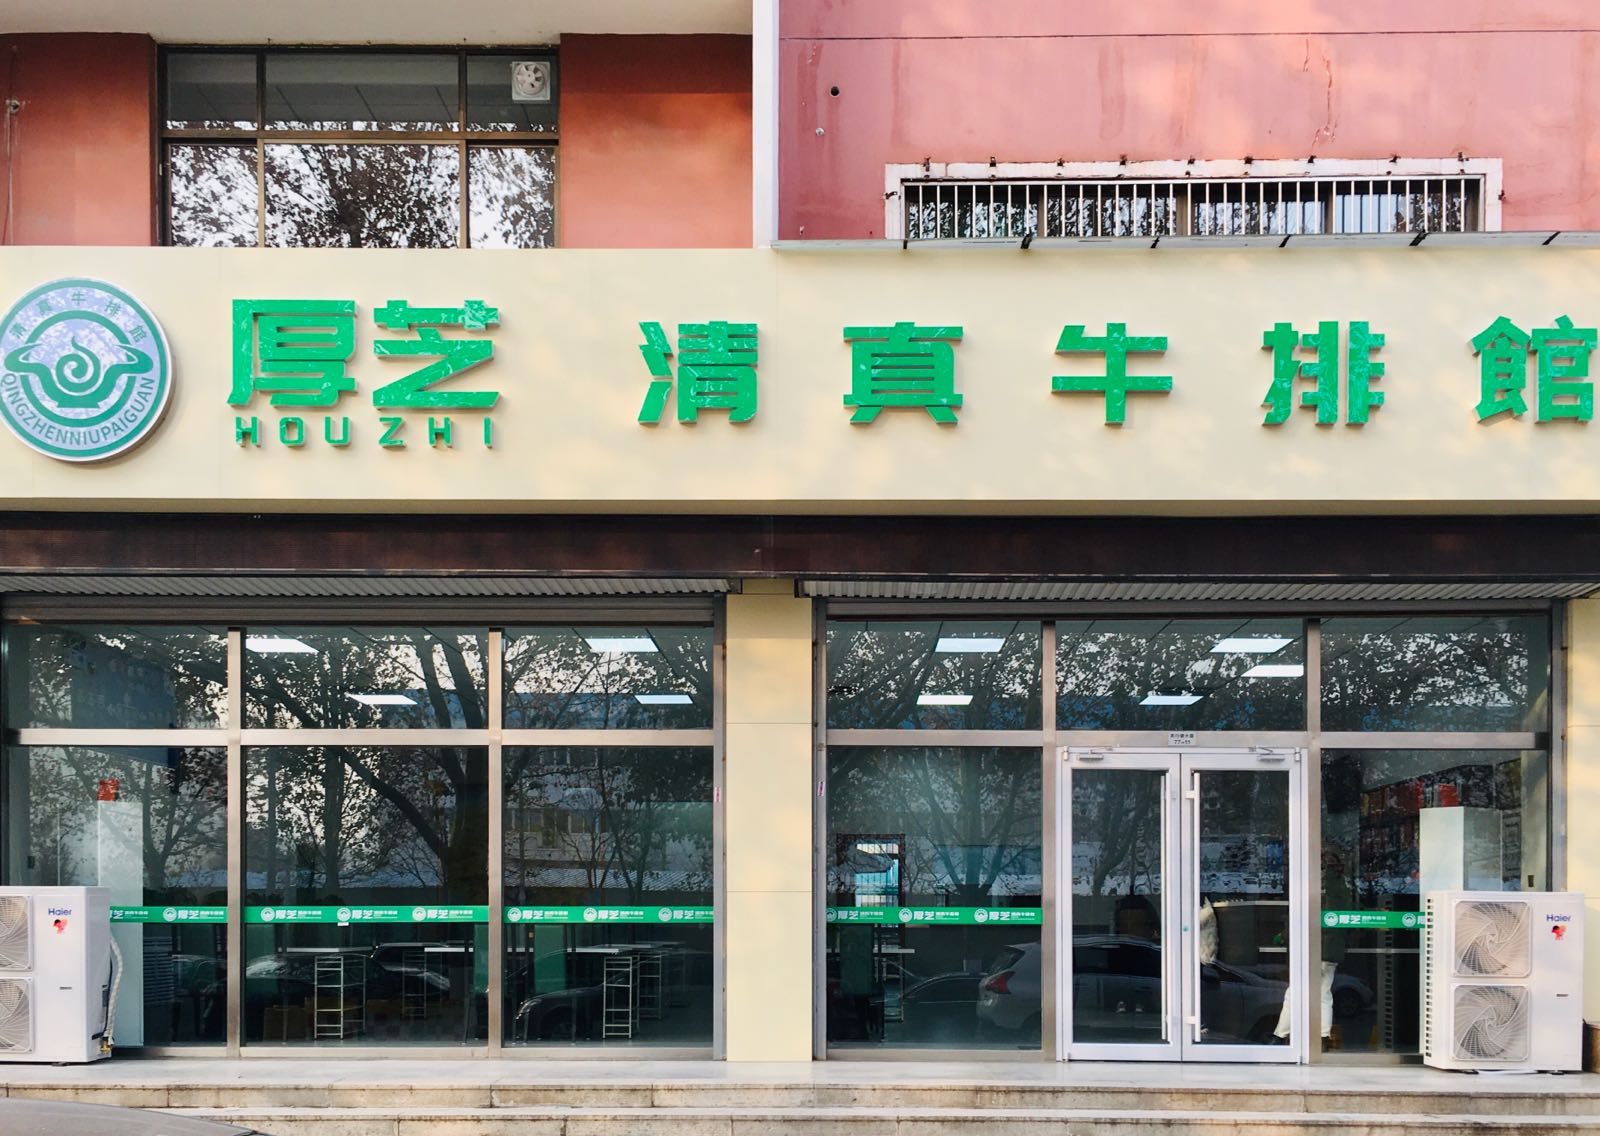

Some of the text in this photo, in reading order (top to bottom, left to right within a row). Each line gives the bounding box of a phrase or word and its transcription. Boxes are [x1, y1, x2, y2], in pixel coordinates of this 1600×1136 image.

[227, 299, 501, 409] 厚芝
[638, 315, 1599, 427] 清真牛排館
[0, 372, 155, 447] QINGZHENNIUPAIGUAN
[235, 415, 492, 448] HOUZHI
[48, 908, 73, 916] Haier
[1546, 914, 1571, 922] Haier
